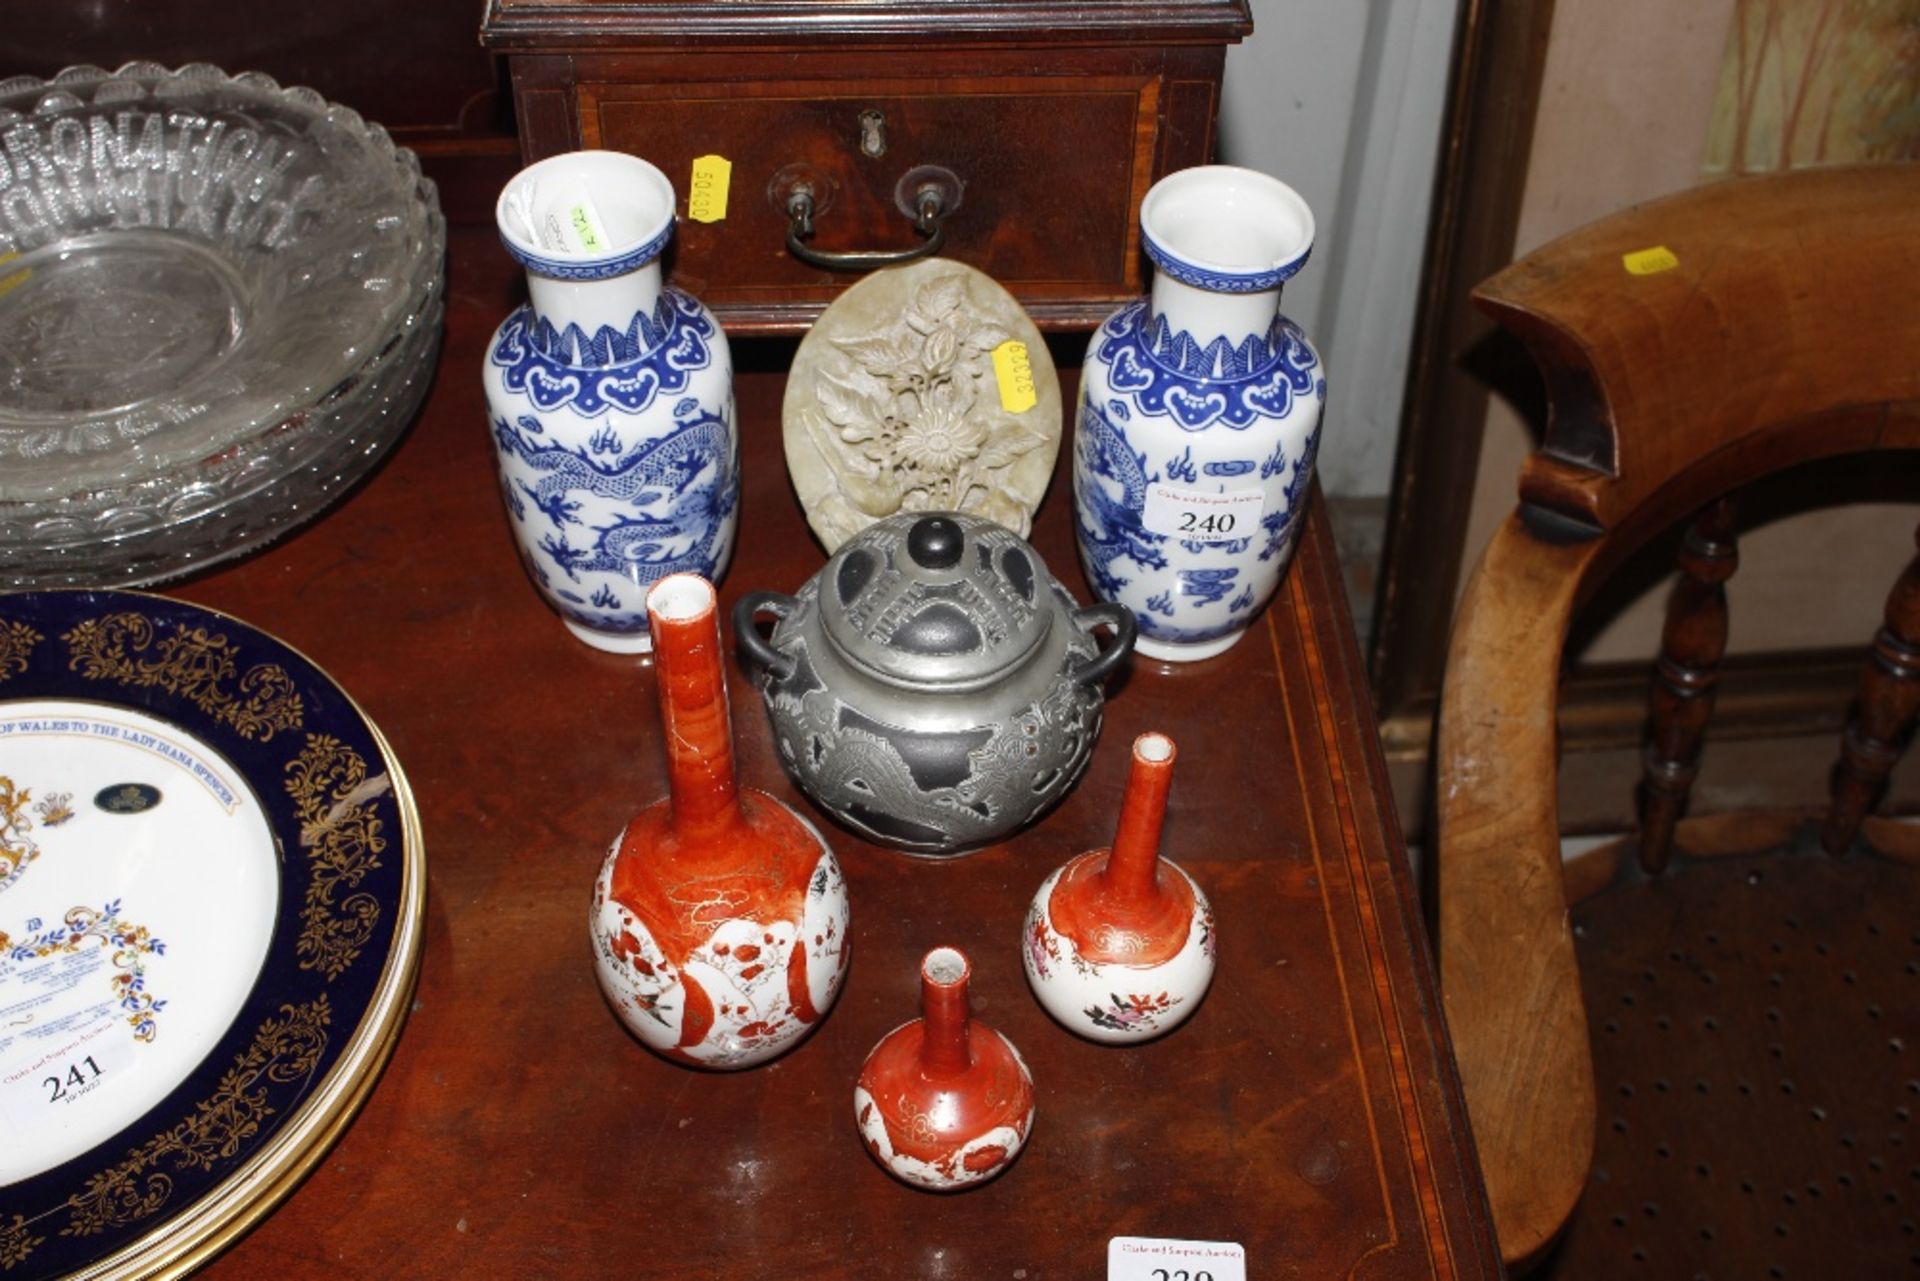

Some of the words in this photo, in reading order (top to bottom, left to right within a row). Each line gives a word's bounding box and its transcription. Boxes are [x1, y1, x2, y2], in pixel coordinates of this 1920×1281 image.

[1177, 512, 1236, 533] 240
[19, 720, 69, 733] WALES
[71, 721, 90, 733] TO
[92, 722, 120, 738] THE
[122, 729, 157, 749] LADY
[156, 741, 194, 769] DIANA
[193, 763, 233, 806] SPENCER
[42, 1055, 104, 1103] 241
